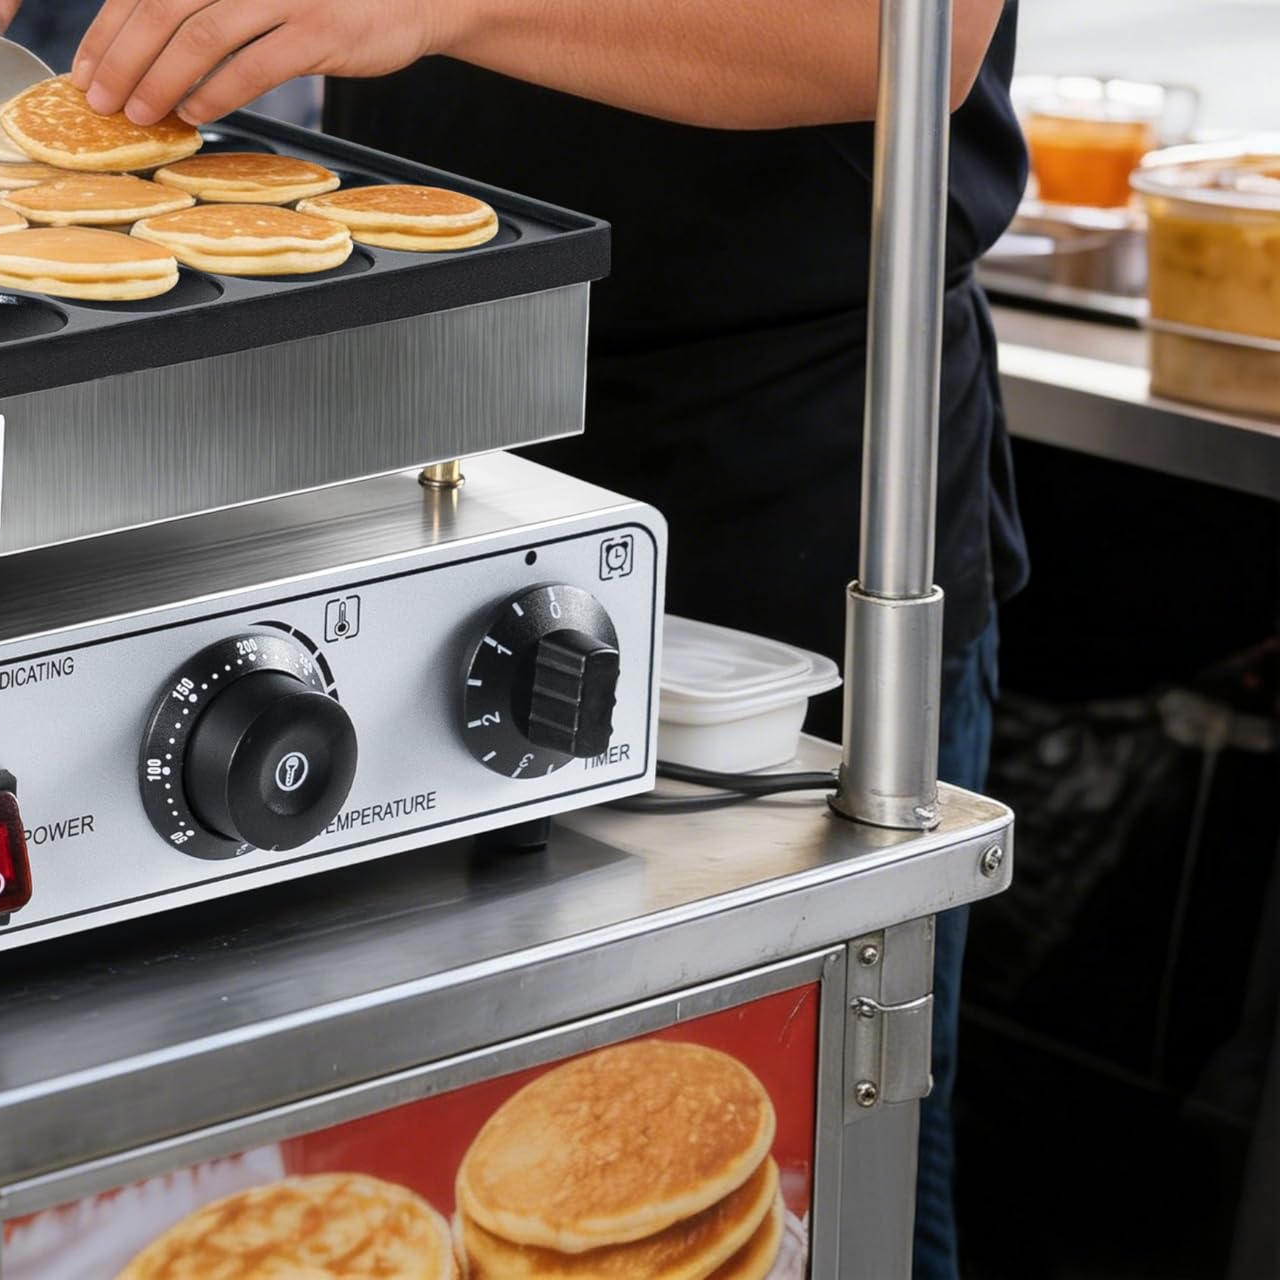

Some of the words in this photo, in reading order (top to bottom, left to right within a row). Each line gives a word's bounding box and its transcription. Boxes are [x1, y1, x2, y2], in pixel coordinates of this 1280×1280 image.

[236, 637, 258, 655] 200
[172, 677, 194, 700] 150
[482, 711, 501, 726] 2
[147, 758, 162, 782] 100
[519, 753, 535, 767] 3
[319, 790, 438, 836] EMPERATURE
